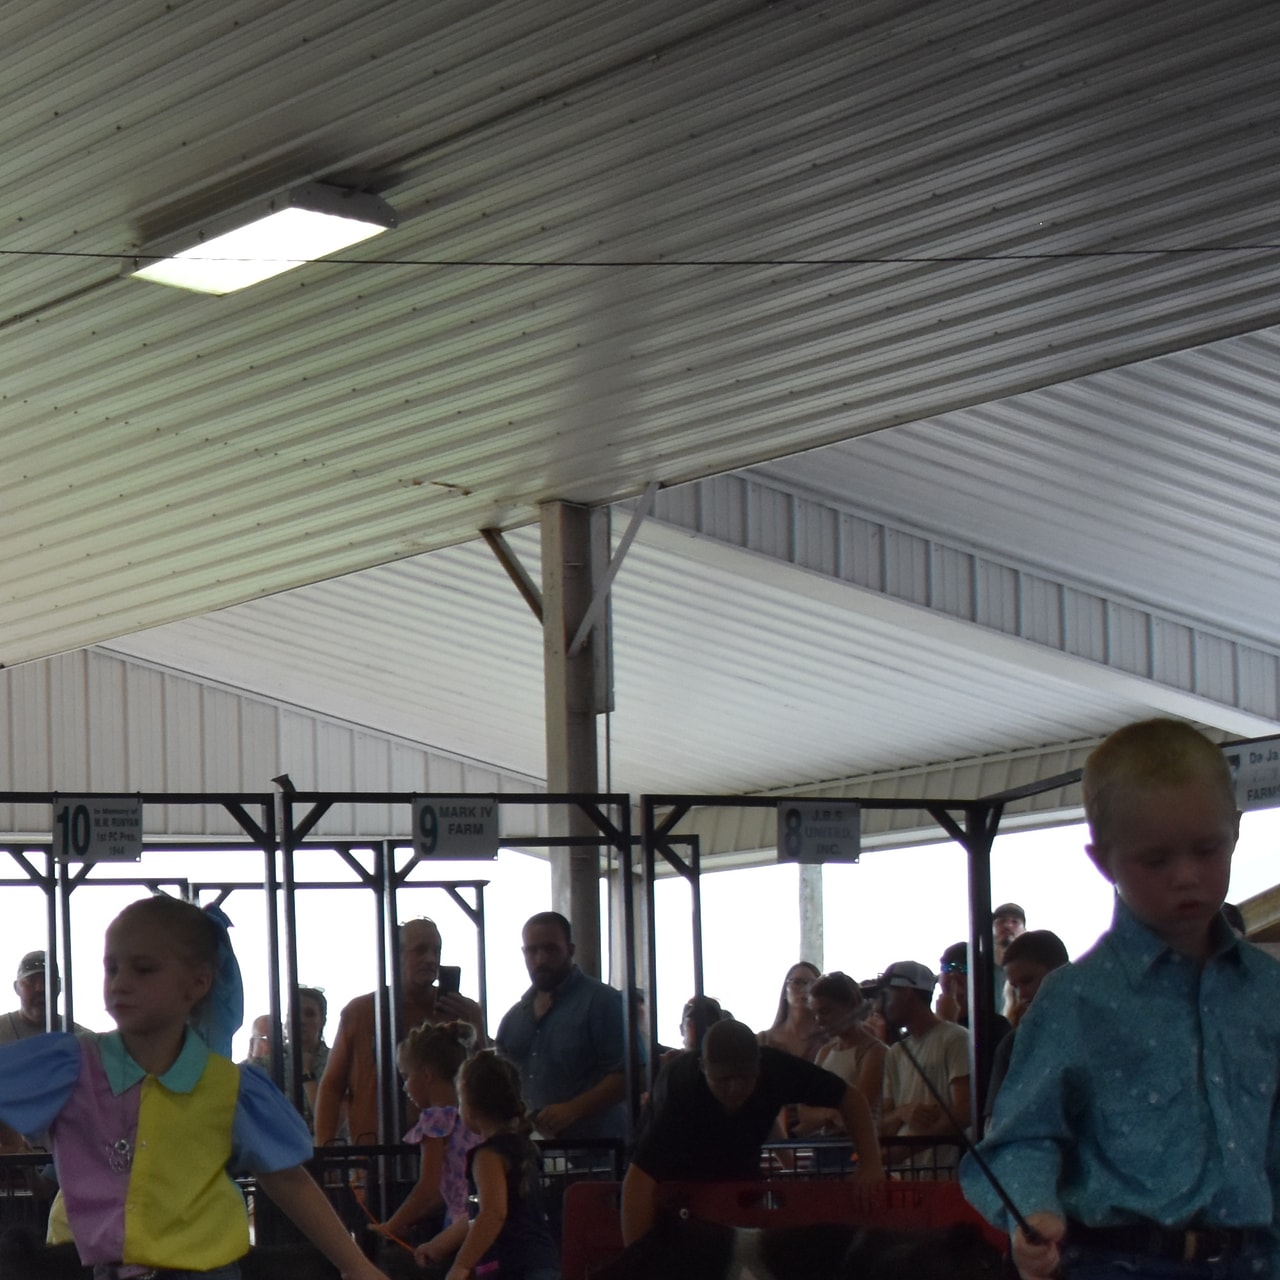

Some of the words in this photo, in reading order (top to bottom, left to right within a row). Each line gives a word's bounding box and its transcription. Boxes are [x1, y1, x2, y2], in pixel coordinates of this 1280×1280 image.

[57, 805, 90, 856] 10
[420, 805, 439, 855] 9
[439, 806, 476, 818] MARK
[481, 806, 493, 818] IV
[448, 824, 484, 835] FARM
[785, 808, 802, 857] 8
